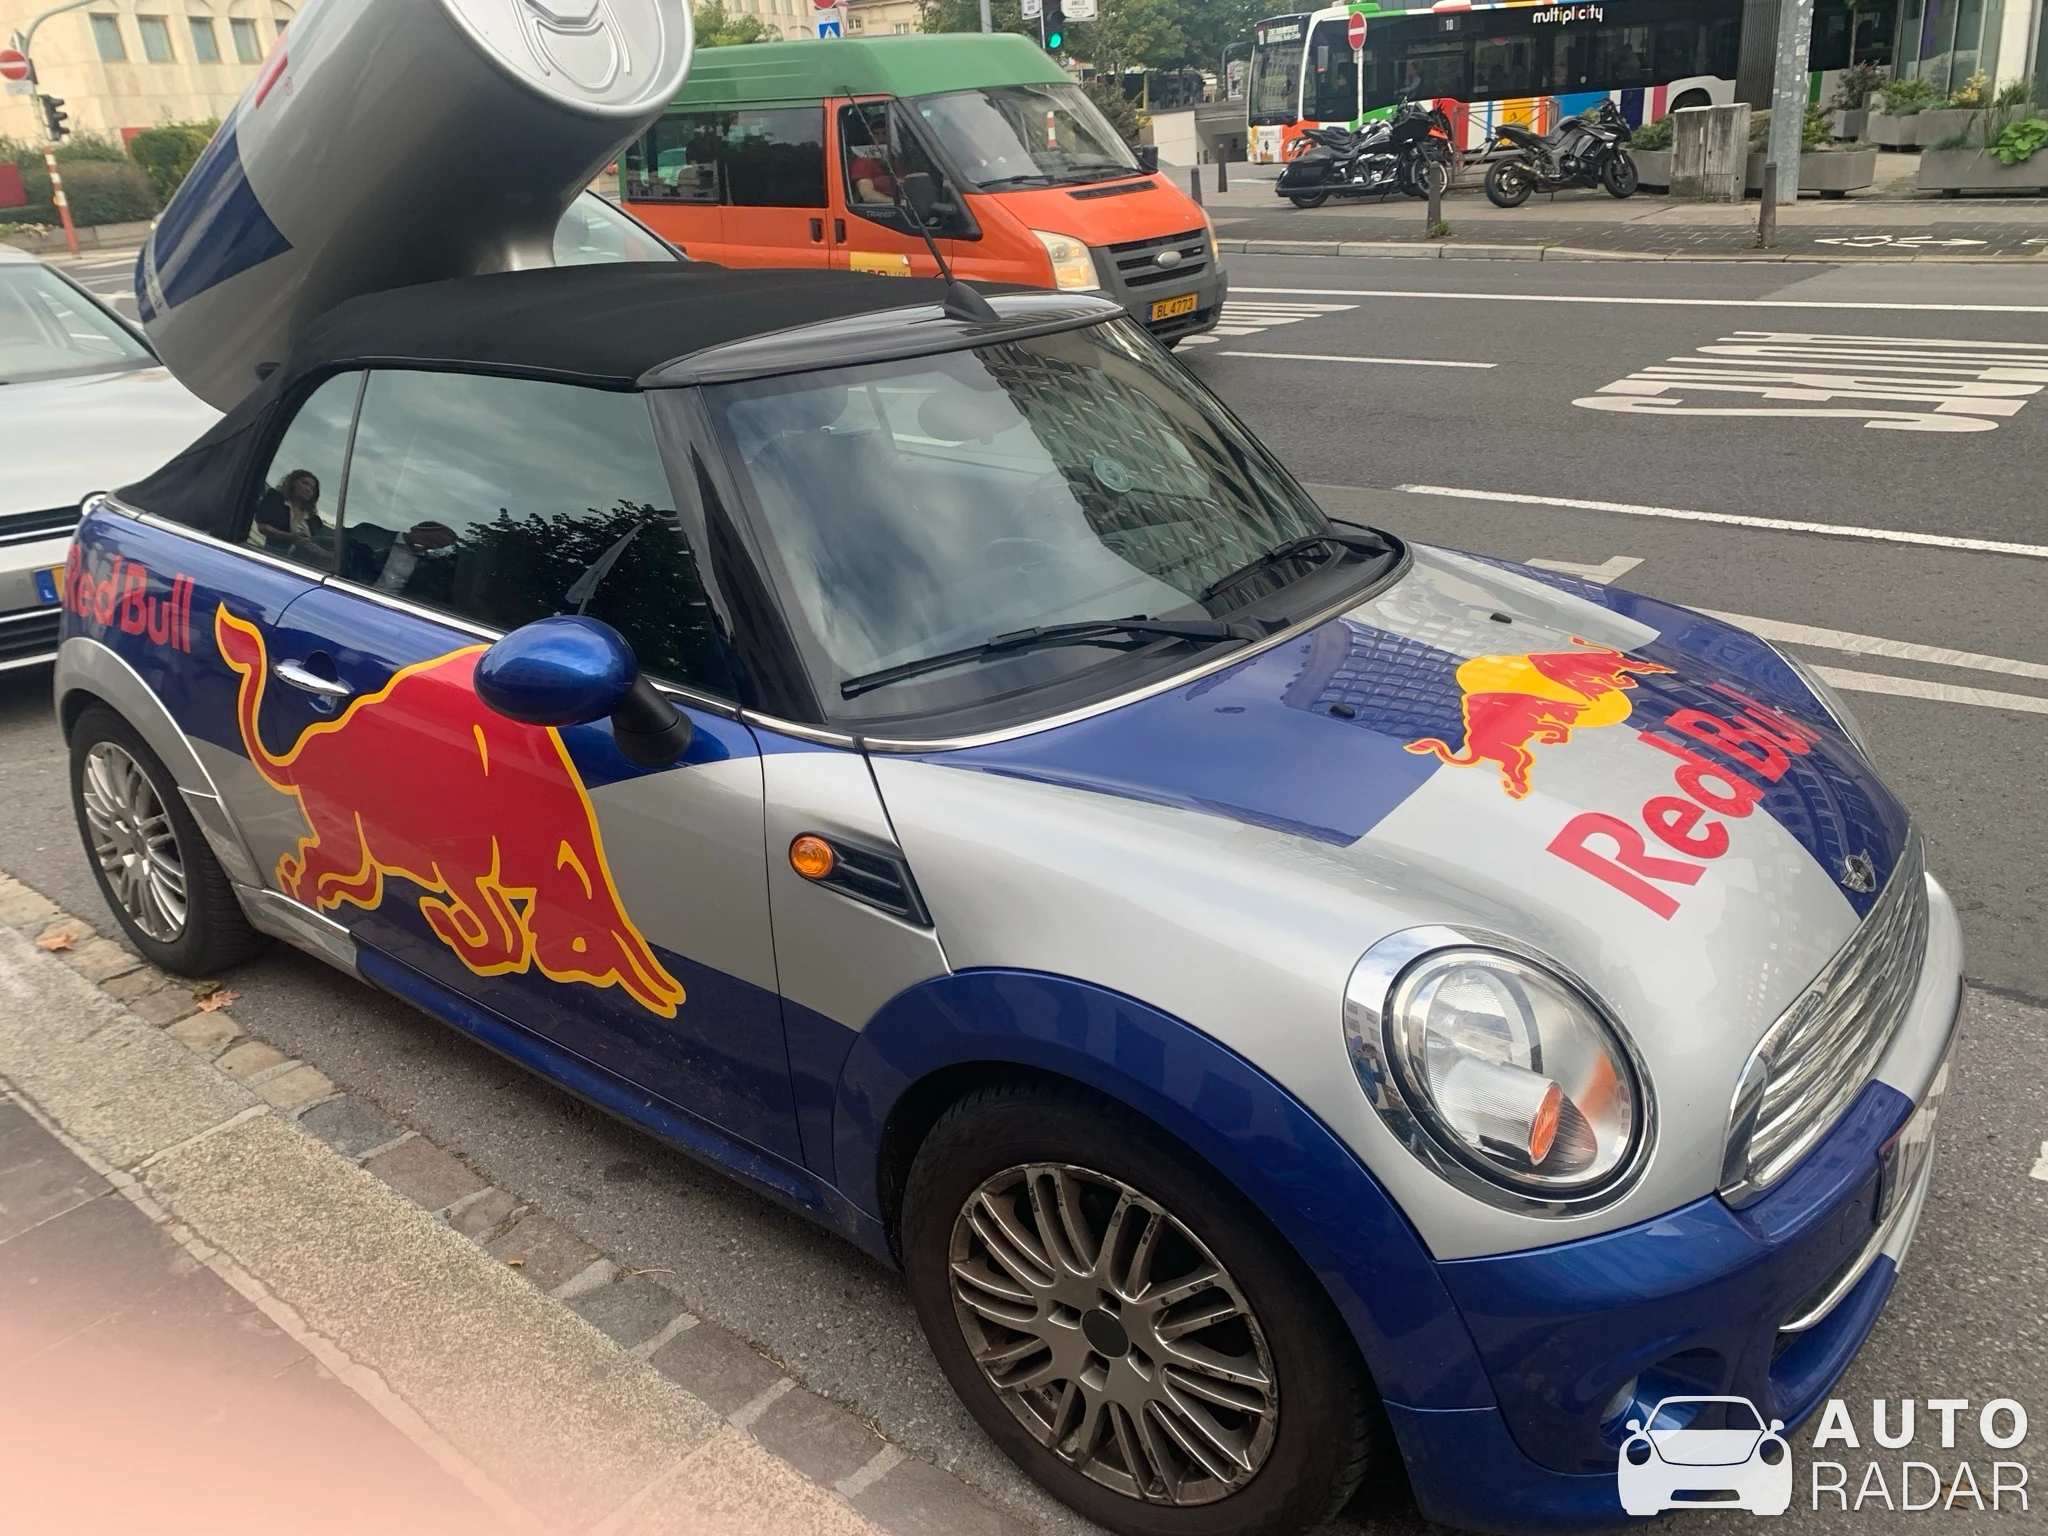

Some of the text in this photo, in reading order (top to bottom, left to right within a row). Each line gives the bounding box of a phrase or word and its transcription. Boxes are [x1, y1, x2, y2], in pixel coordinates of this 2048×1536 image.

[1445, 19, 1454, 31] 10
[1533, 4, 1603, 25] multiplicity
[866, 210, 896, 218] TRANSIT
[1156, 297, 1194, 318] BL 4773
[64, 543, 195, 654] Red Bull
[1545, 730, 1765, 921] Red
